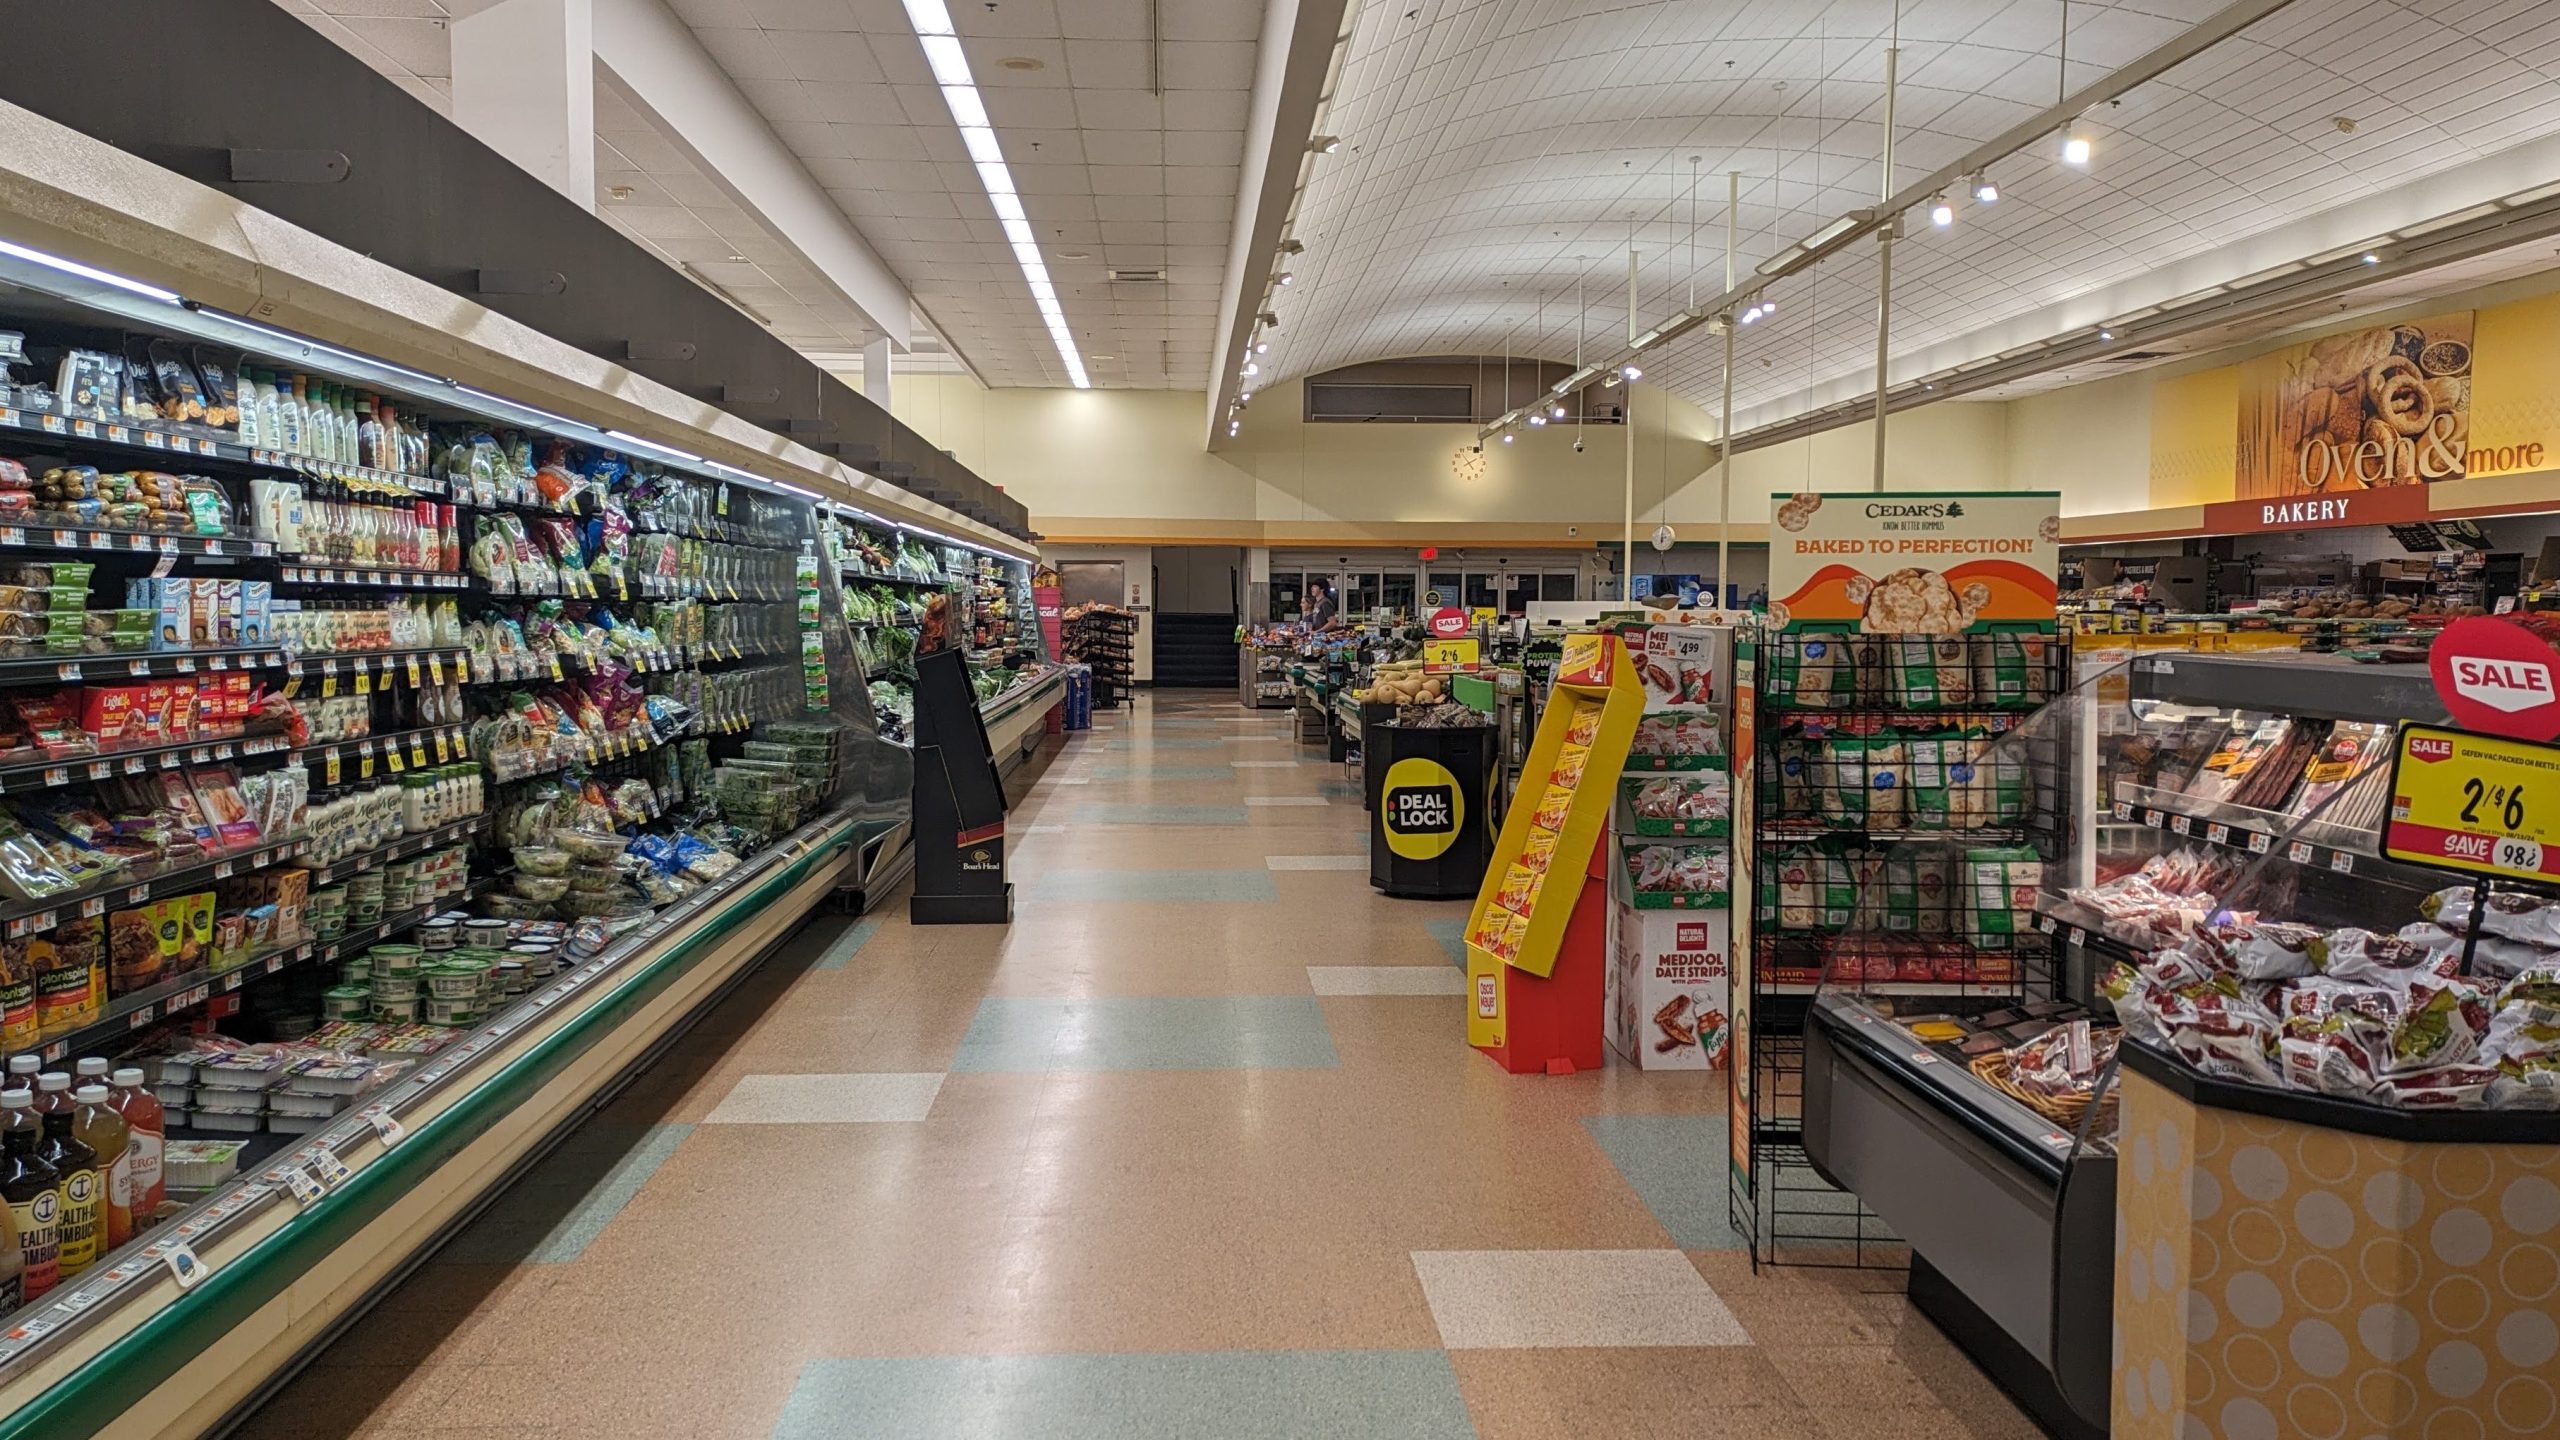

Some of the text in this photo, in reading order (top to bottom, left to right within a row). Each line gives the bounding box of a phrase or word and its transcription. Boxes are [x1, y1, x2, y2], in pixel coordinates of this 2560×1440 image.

[1865, 502, 1945, 519] CEDAR'S
[2262, 498, 2350, 524] BAKERY
[1795, 538, 2034, 554] BAKED TO PERFECTION!
[1438, 618, 1462, 628] SALE
[1527, 652, 1560, 660] PROTEIN
[1527, 659, 1550, 667] POW
[2458, 661, 2548, 692] SALE
[2411, 739, 2451, 754] SALE
[2461, 749, 2483, 759] GEFEN
[2483, 752, 2498, 761] VAC
[2498, 754, 2526, 765] PACKED
[2525, 759, 2535, 767] OR
[2535, 760, 2555, 770] BEETS
[1400, 793, 1447, 810] DEAL
[1400, 809, 1448, 827] LOCK
[2444, 834, 2490, 856] SAVE
[963, 862, 1000, 871] Boar's Head
[1679, 928, 1705, 936] NATURAL
[1679, 935, 1705, 943] DELIGHTS
[1659, 953, 1724, 966] MEDJOOL
[1656, 966, 1728, 978] DATE STRIPS
[1480, 983, 1494, 995] Oscar
[1480, 995, 1496, 1009] Mayer
